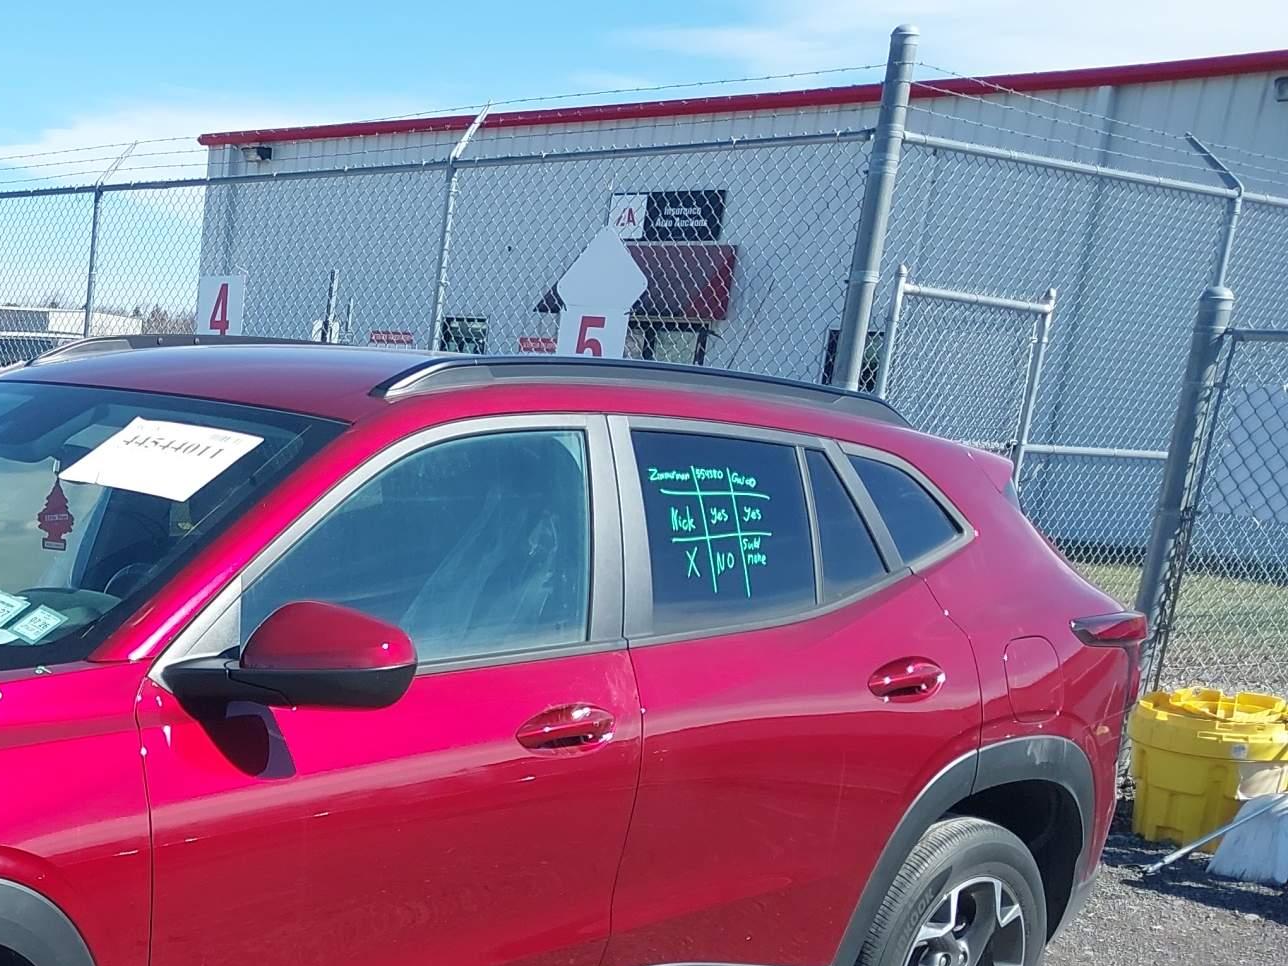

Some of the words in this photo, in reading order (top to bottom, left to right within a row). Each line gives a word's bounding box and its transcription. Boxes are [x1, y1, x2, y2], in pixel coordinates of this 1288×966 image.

[209, 283, 229, 336] 4
[575, 316, 607, 357] 5
[122, 435, 225, 460] 44544011
